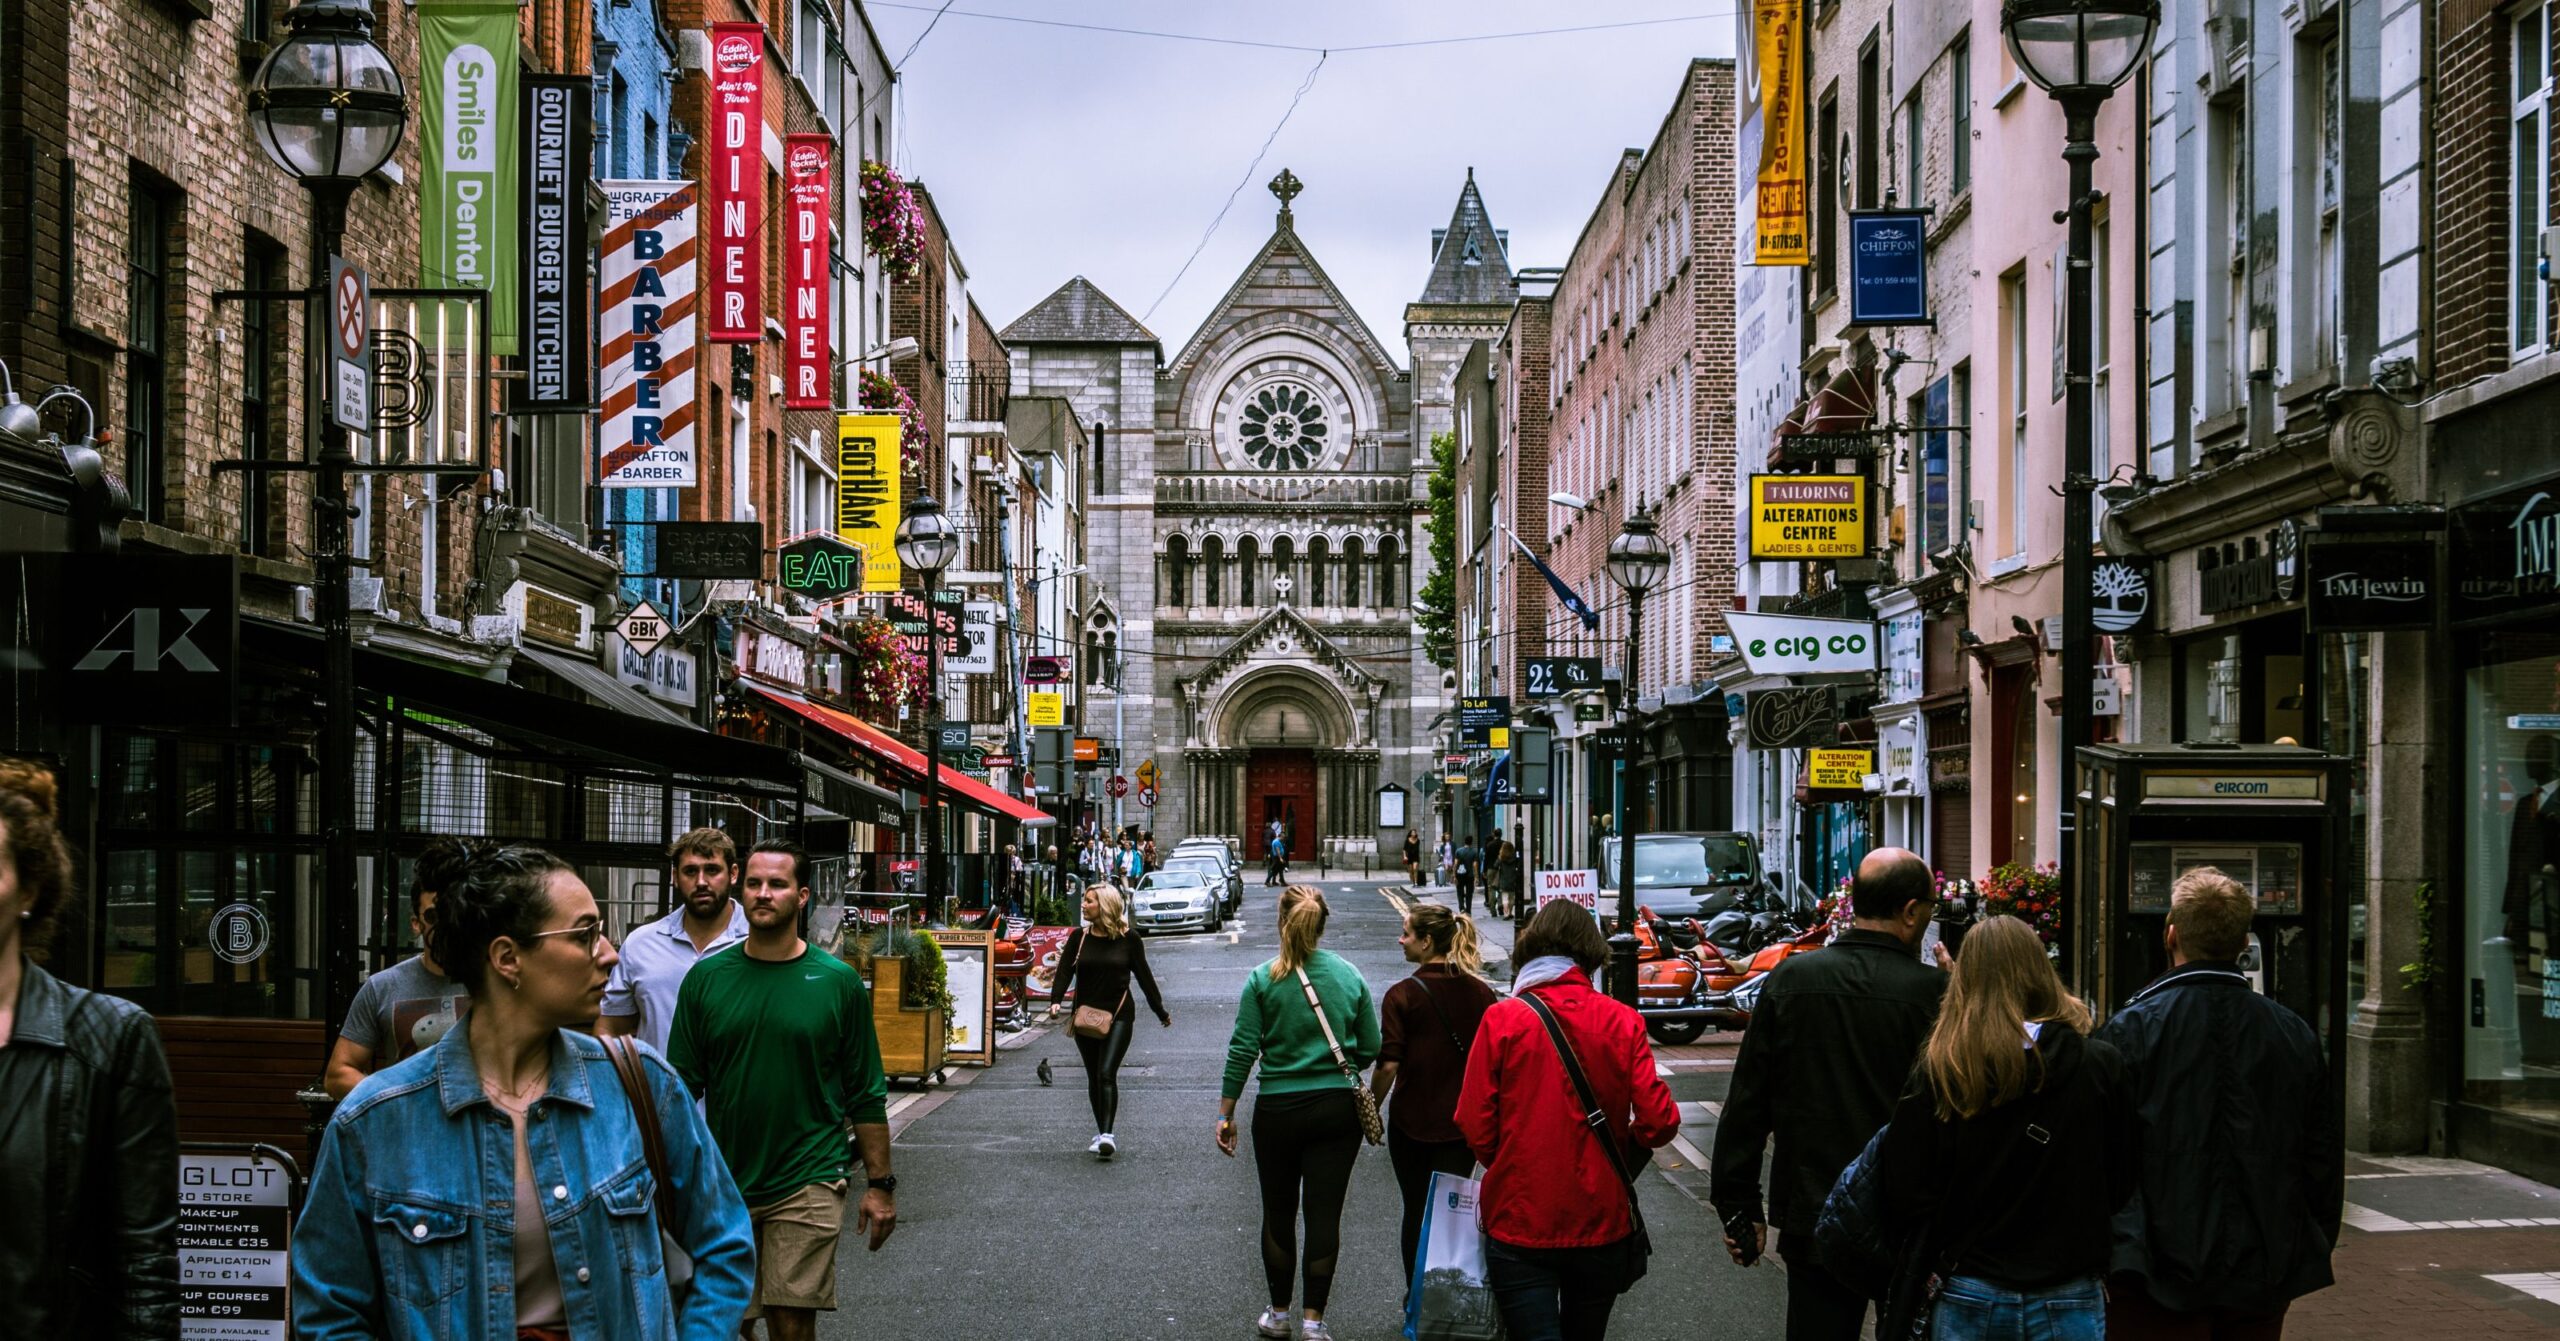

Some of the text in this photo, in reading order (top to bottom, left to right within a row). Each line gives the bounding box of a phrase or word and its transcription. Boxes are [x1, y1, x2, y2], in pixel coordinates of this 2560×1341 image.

[723, 44, 748, 54] Eddie
[716, 81, 742, 91] Ain't
[724, 93, 750, 103] Finer
[1774, 23, 1790, 174] ALTERATION
[457, 61, 484, 161] Smiles
[795, 152, 817, 161] Eddie
[622, 191, 690, 204] GRAFTON
[1761, 184, 1803, 213] CENTRE
[610, 192, 621, 219] THE
[624, 208, 683, 221] BARBER
[724, 112, 746, 328] DINER
[457, 180, 483, 283] Dental
[537, 88, 562, 401] GOURMET BURGER KITCHEN
[1859, 240, 1916, 252] CHIFFON
[1874, 277, 1883, 285] 01
[798, 211, 817, 397] DINER
[632, 230, 666, 446] BARBER
[1787, 437, 1872, 456] RESTAURANT
[620, 450, 689, 462] GRAFTON
[623, 467, 682, 479] BARBER
[841, 437, 890, 528] GOTHAM
[1770, 486, 1849, 499] TAILORING
[1763, 508, 1858, 522] ALTERATIONS
[666, 531, 754, 548] GRAFTON
[1783, 526, 1837, 540] CENTRE
[1763, 543, 1857, 553] LADIES & GENTS
[672, 551, 748, 568] BARBER
[785, 551, 856, 589] EAT
[869, 563, 896, 571] URANT
[932, 591, 962, 604] INES
[629, 622, 659, 637] GBK
[72, 608, 221, 672] AK
[1749, 639, 1767, 658] e
[1774, 636, 1821, 661] cig
[1828, 634, 1867, 654] co
[623, 642, 657, 682] GALLERY
[657, 654, 663, 685] @
[677, 660, 688, 692] SIX
[1462, 700, 1488, 708] To Let
[942, 731, 967, 743] SO
[1817, 753, 1865, 761] ALTERATION
[1106, 784, 1128, 792] SOP
[2214, 782, 2269, 794] eircom
[1546, 873, 1586, 888] DO NOT
[1570, 893, 1595, 908] THIS
[229, 916, 254, 951] B
[183, 1167, 276, 1187] GLOT
[203, 1193, 253, 1202] STORE
[238, 1238, 270, 1248] €35
[199, 1271, 216, 1279] TO
[221, 1271, 253, 1279] €14
[207, 1292, 270, 1301] COURSES
[211, 1305, 242, 1315] €99
[182, 1327, 272, 1336] STUDIO AVAILABLE
